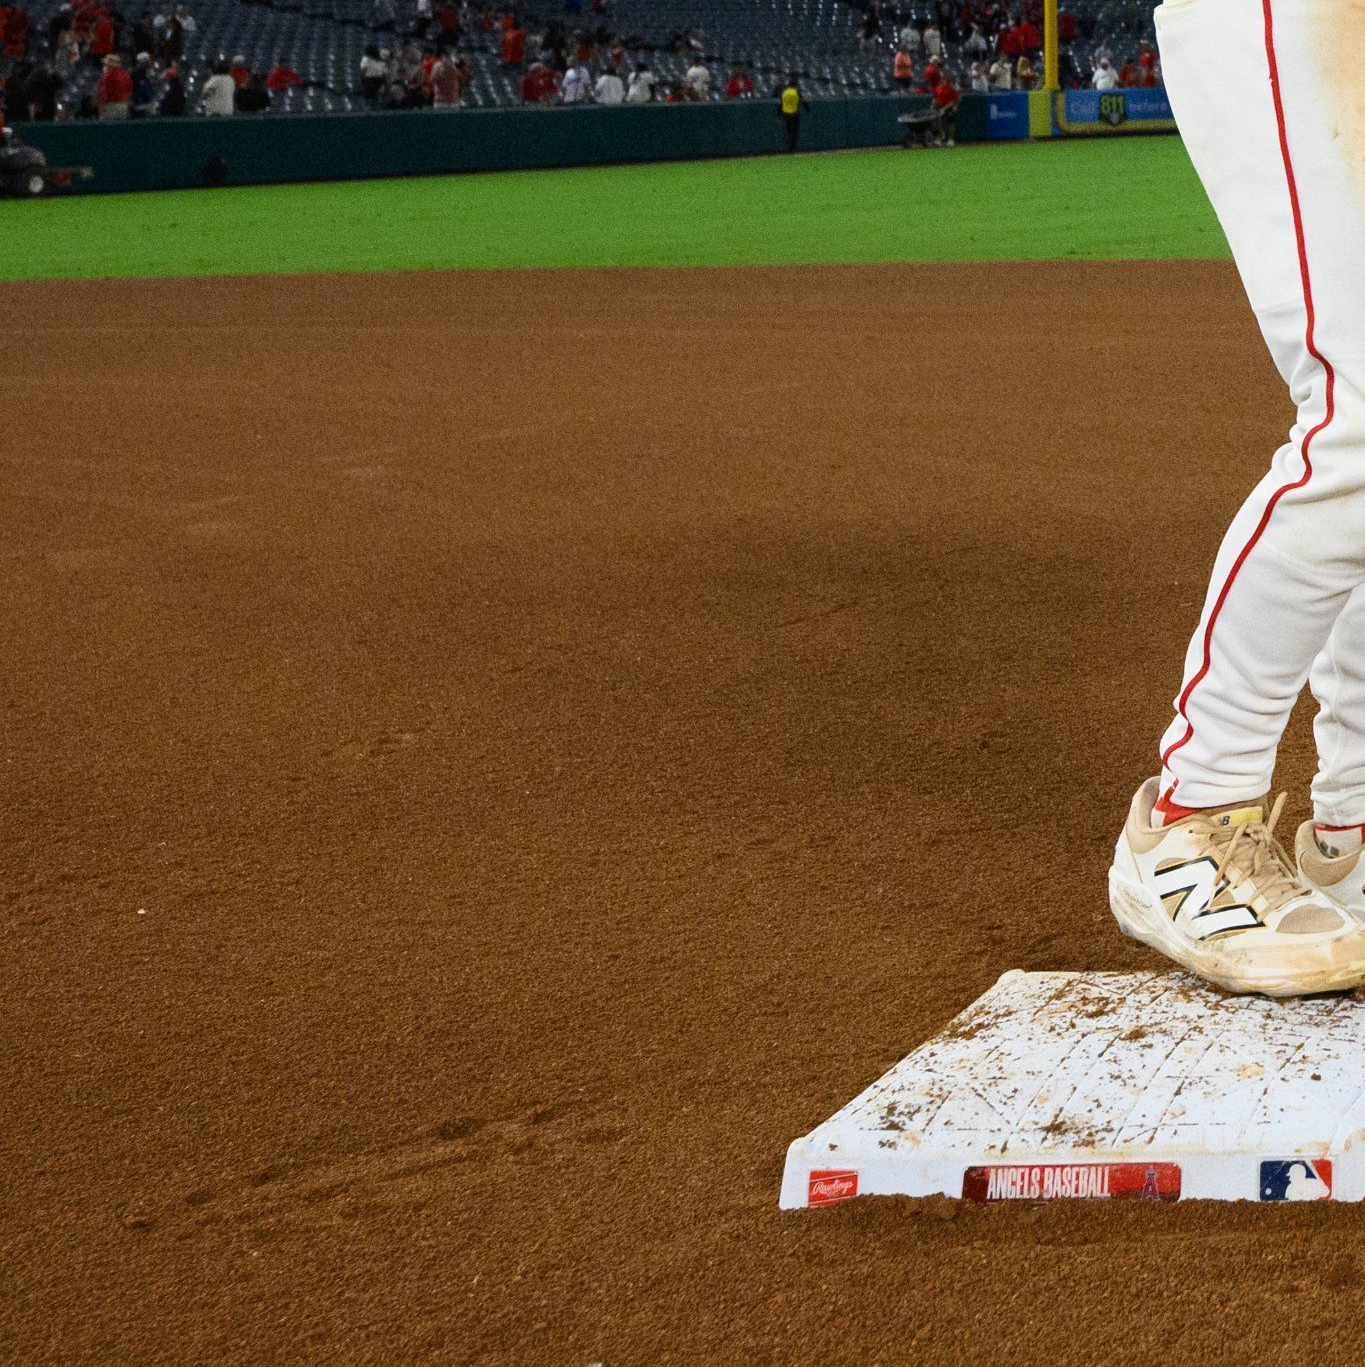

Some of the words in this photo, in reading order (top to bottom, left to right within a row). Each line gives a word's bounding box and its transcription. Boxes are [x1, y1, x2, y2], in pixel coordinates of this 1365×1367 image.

[1101, 93, 1124, 114] 811
[986, 1167, 1040, 1200] ANGELS
[1043, 1165, 1111, 1199] BASEBALL
